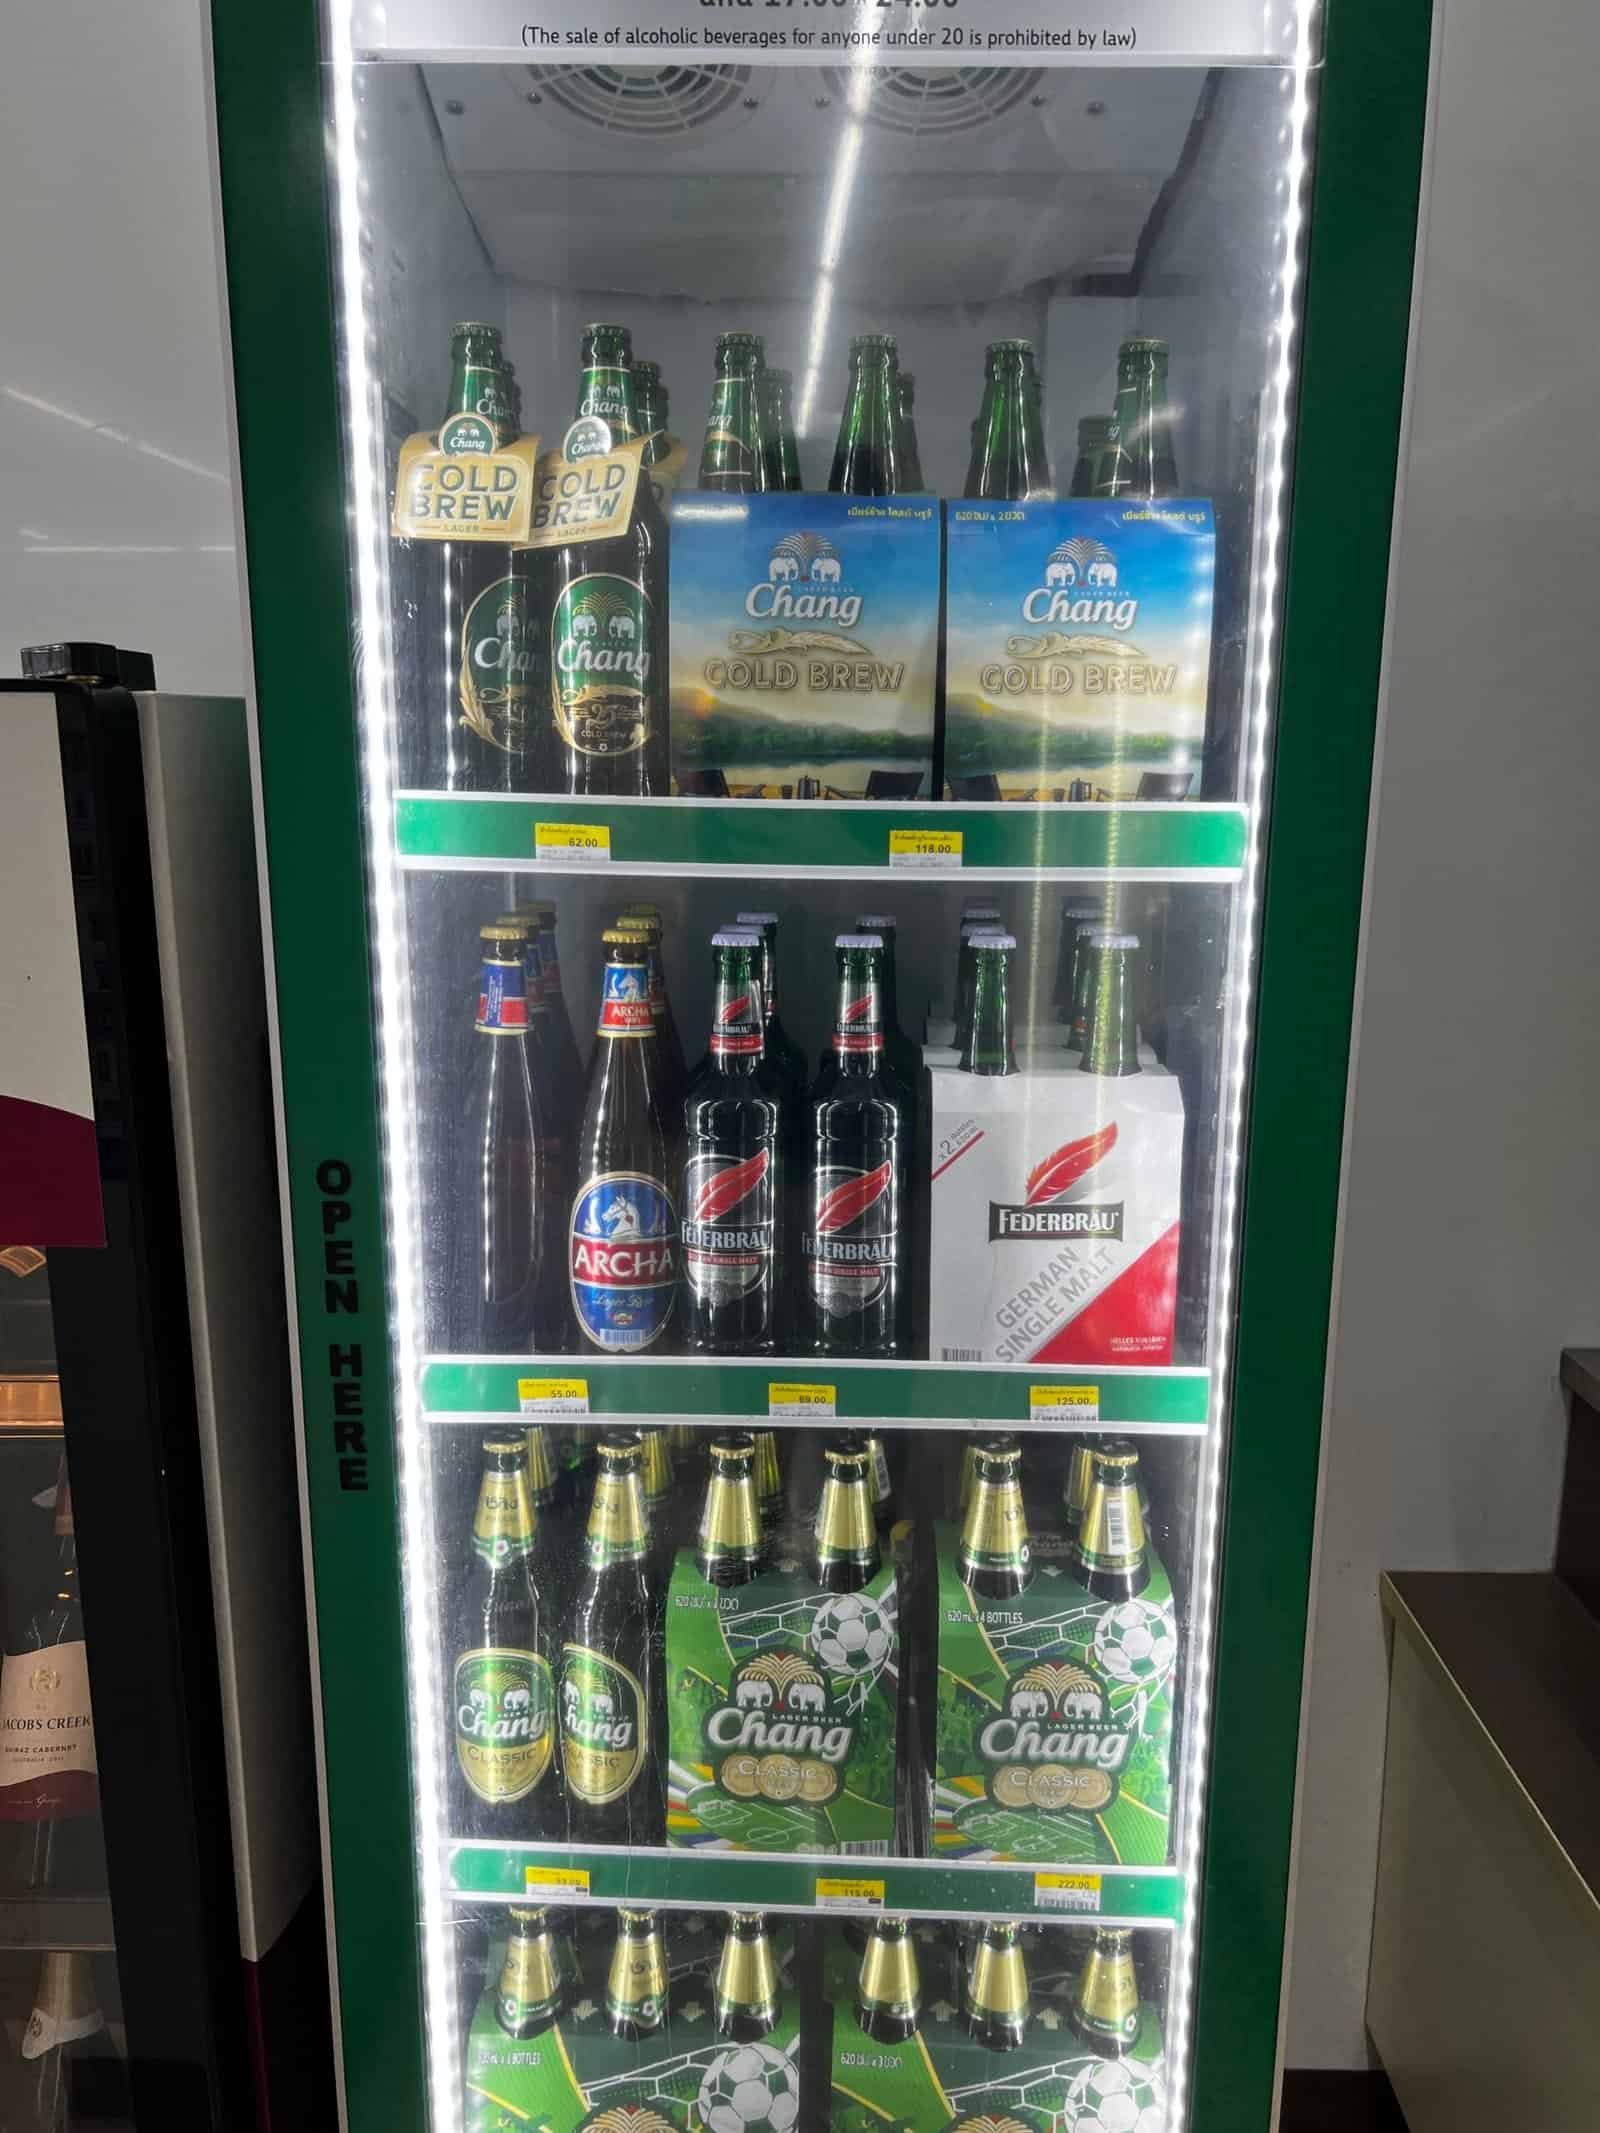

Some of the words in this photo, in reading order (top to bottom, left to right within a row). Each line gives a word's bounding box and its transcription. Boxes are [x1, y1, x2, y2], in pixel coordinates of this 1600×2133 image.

[521, 24, 560, 47] (The
[566, 26, 599, 45] sale
[604, 26, 621, 45] of
[625, 26, 699, 45] alcoholic
[704, 27, 787, 48] beverages
[793, 28, 815, 46] for
[821, 31, 881, 49] anyone
[887, 29, 936, 46] under
[942, 28, 963, 46] 20
[970, 29, 982, 46] is
[988, 29, 1071, 49] prohibited
[1078, 29, 1097, 49] by
[1102, 27, 1137, 49] law)
[450, 436, 486, 450] Chang
[416, 463, 517, 493] COLD
[539, 462, 627, 501] COLD
[409, 495, 516, 522] BREW
[533, 496, 621, 529] BREW
[745, 582, 863, 628] Chang
[1022, 588, 1138, 632] Chang
[557, 639, 651, 681] Chang
[704, 659, 798, 691] COLD
[808, 661, 906, 693] BREW
[980, 663, 1074, 695] COLD
[1084, 664, 1178, 696] BREW
[611, 1003, 650, 1017] ARCHA
[316, 1160, 359, 1313] OPEN
[574, 1244, 673, 1278] ARCHA
[995, 1246, 1080, 1330] GERMAN
[995, 1294, 1065, 1362] SINGLE
[1060, 1245, 1115, 1307] MALT
[329, 1344, 369, 1490] HERE
[987, 1611, 1024, 1625] BOTTLES
[47, 1714, 91, 1731] CREEK
[458, 1704, 546, 1740] Chang
[565, 1703, 633, 1749] hang
[708, 1707, 853, 1763] Chang
[467, 1745, 538, 1764] CLASSIC
[572, 1750, 621, 1769] ASSIC
[980, 1719, 1129, 1769] Chang
[738, 1760, 817, 1778] CLASSIC
[1010, 1769, 1090, 1788] CLASSIC
